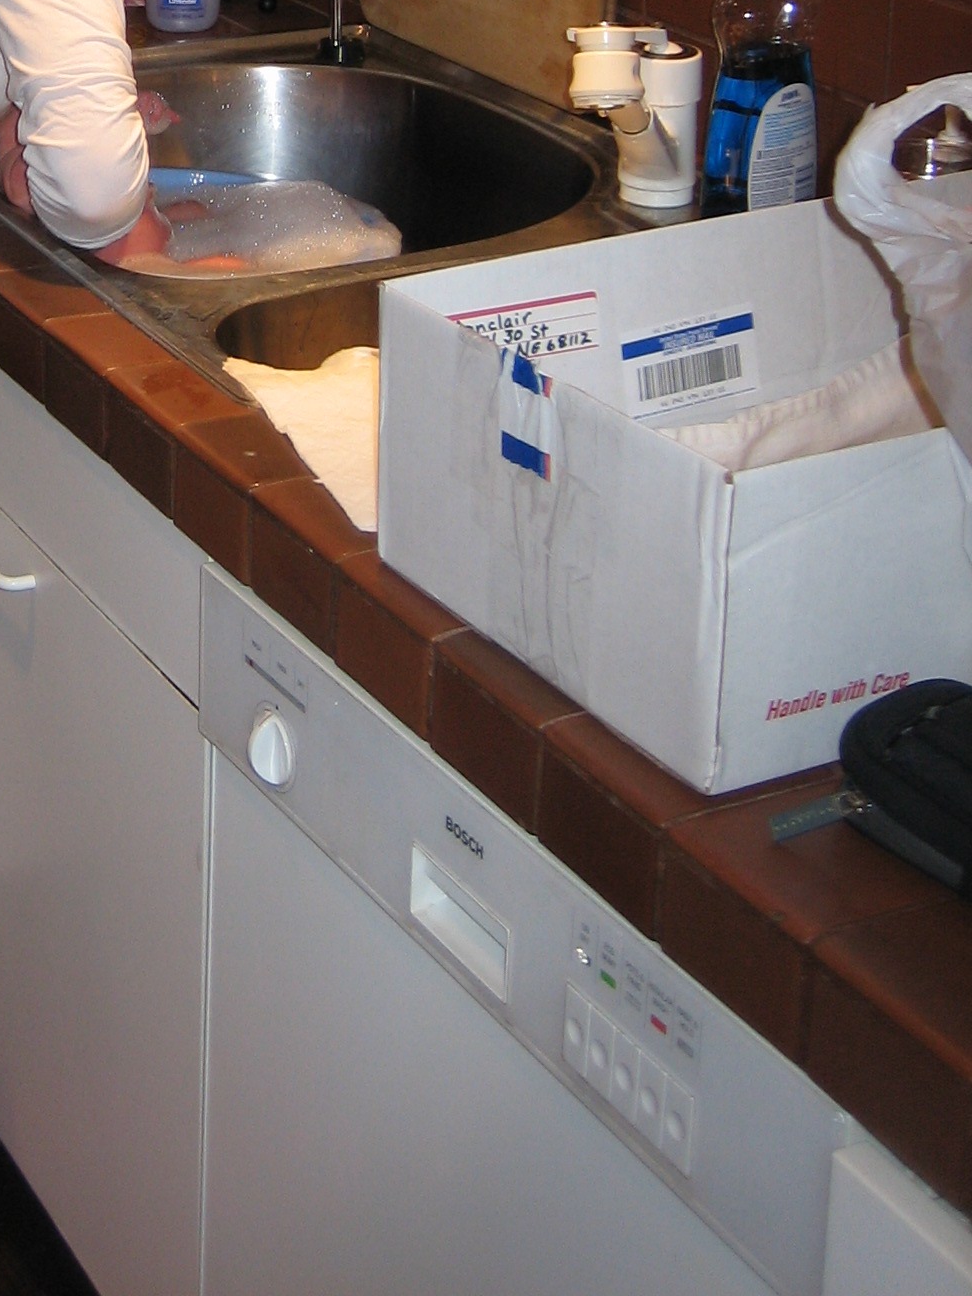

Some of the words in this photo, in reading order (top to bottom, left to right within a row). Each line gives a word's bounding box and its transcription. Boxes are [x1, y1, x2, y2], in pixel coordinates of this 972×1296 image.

[503, 329, 523, 344] 30
[530, 323, 549, 340] St
[546, 330, 592, 352] 68112
[765, 689, 827, 721] Handle
[831, 679, 868, 704] with
[871, 671, 910, 694] Care
[445, 814, 484, 859] BOSCH
